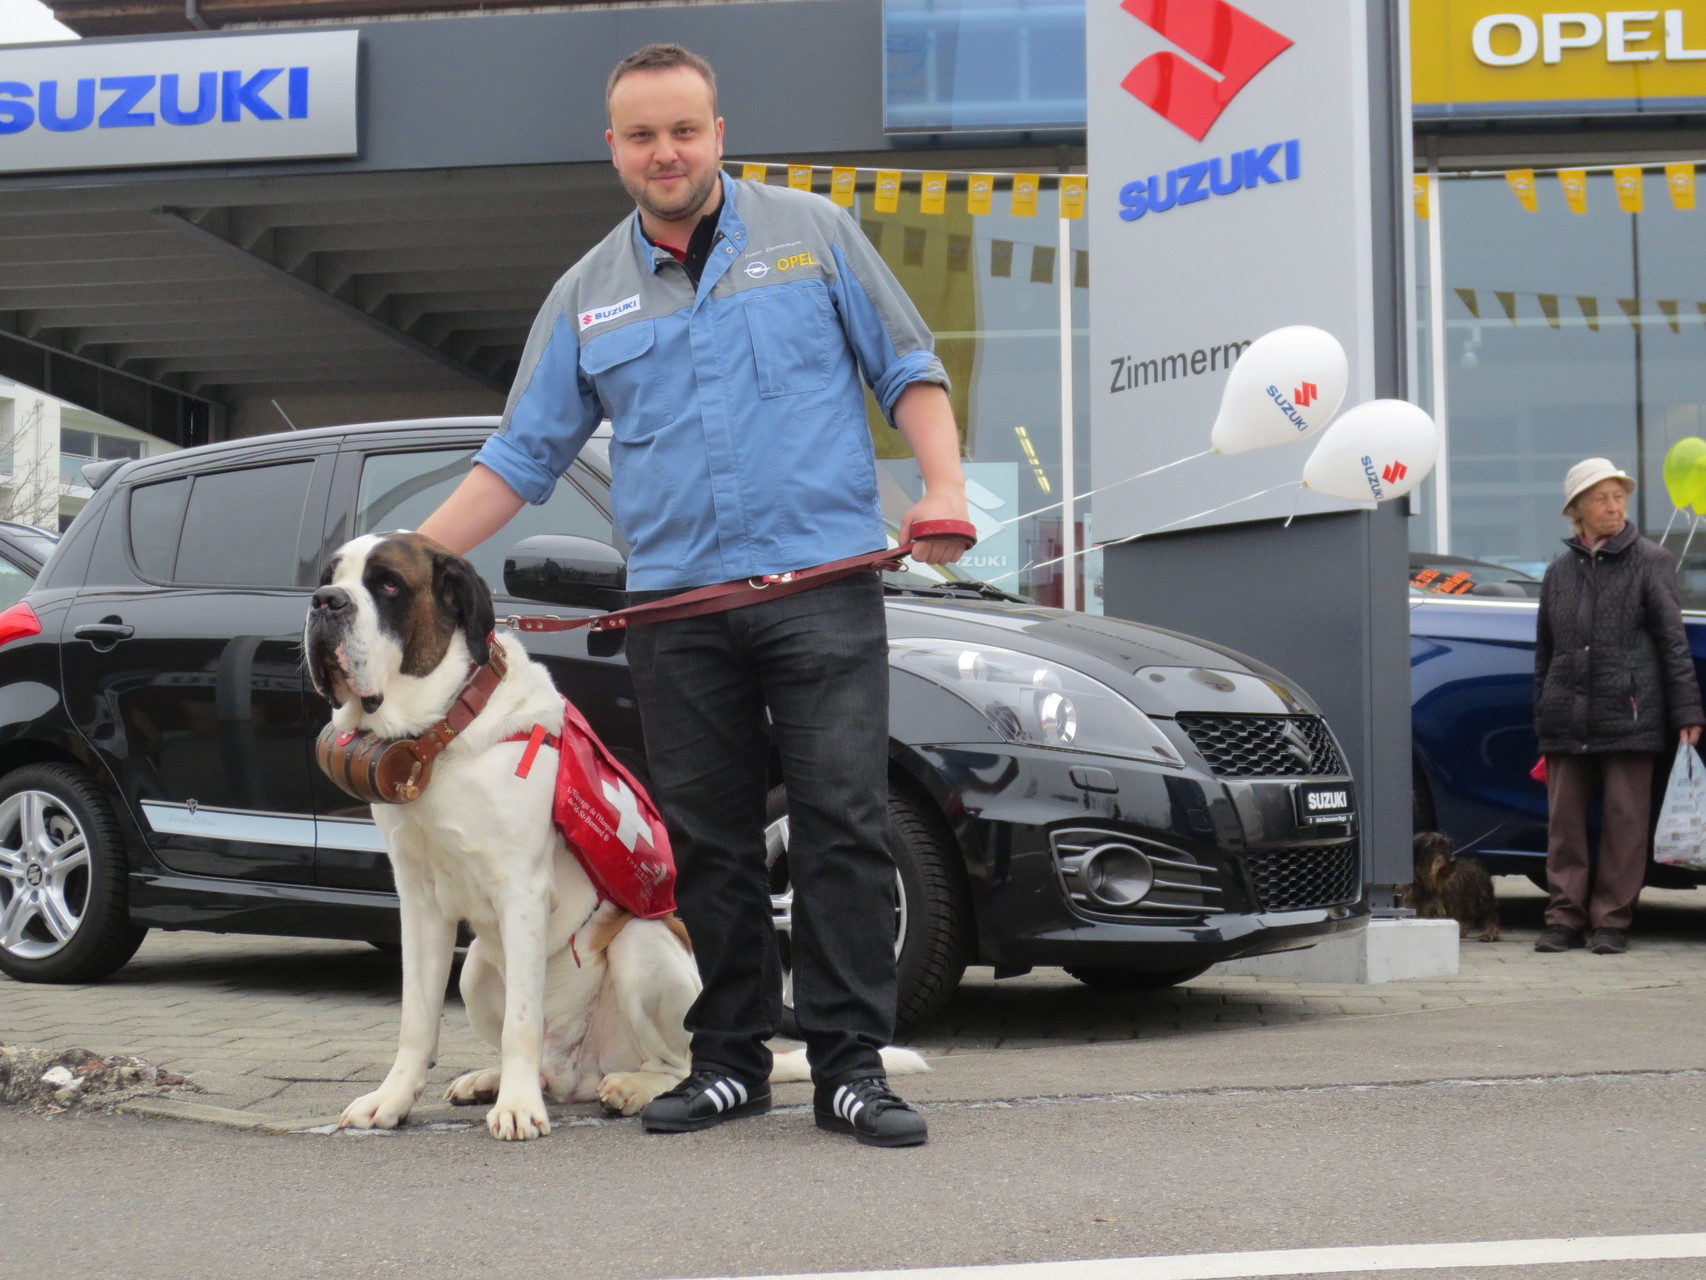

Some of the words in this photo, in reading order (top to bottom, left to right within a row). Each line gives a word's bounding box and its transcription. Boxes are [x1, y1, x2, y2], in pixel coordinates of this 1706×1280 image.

[1472, 9, 1706, 66] OPEL
[0, 66, 309, 135] SUZUKI
[1118, 138, 1300, 221] SUZUKI
[776, 252, 818, 271] OPEL
[594, 300, 637, 320] SUZUKI
[1265, 384, 1309, 432] SUZUKI
[1360, 455, 1384, 500] SUZUKI
[959, 555, 1007, 567] ZUKI
[1308, 792, 1347, 809] SUZUKI
